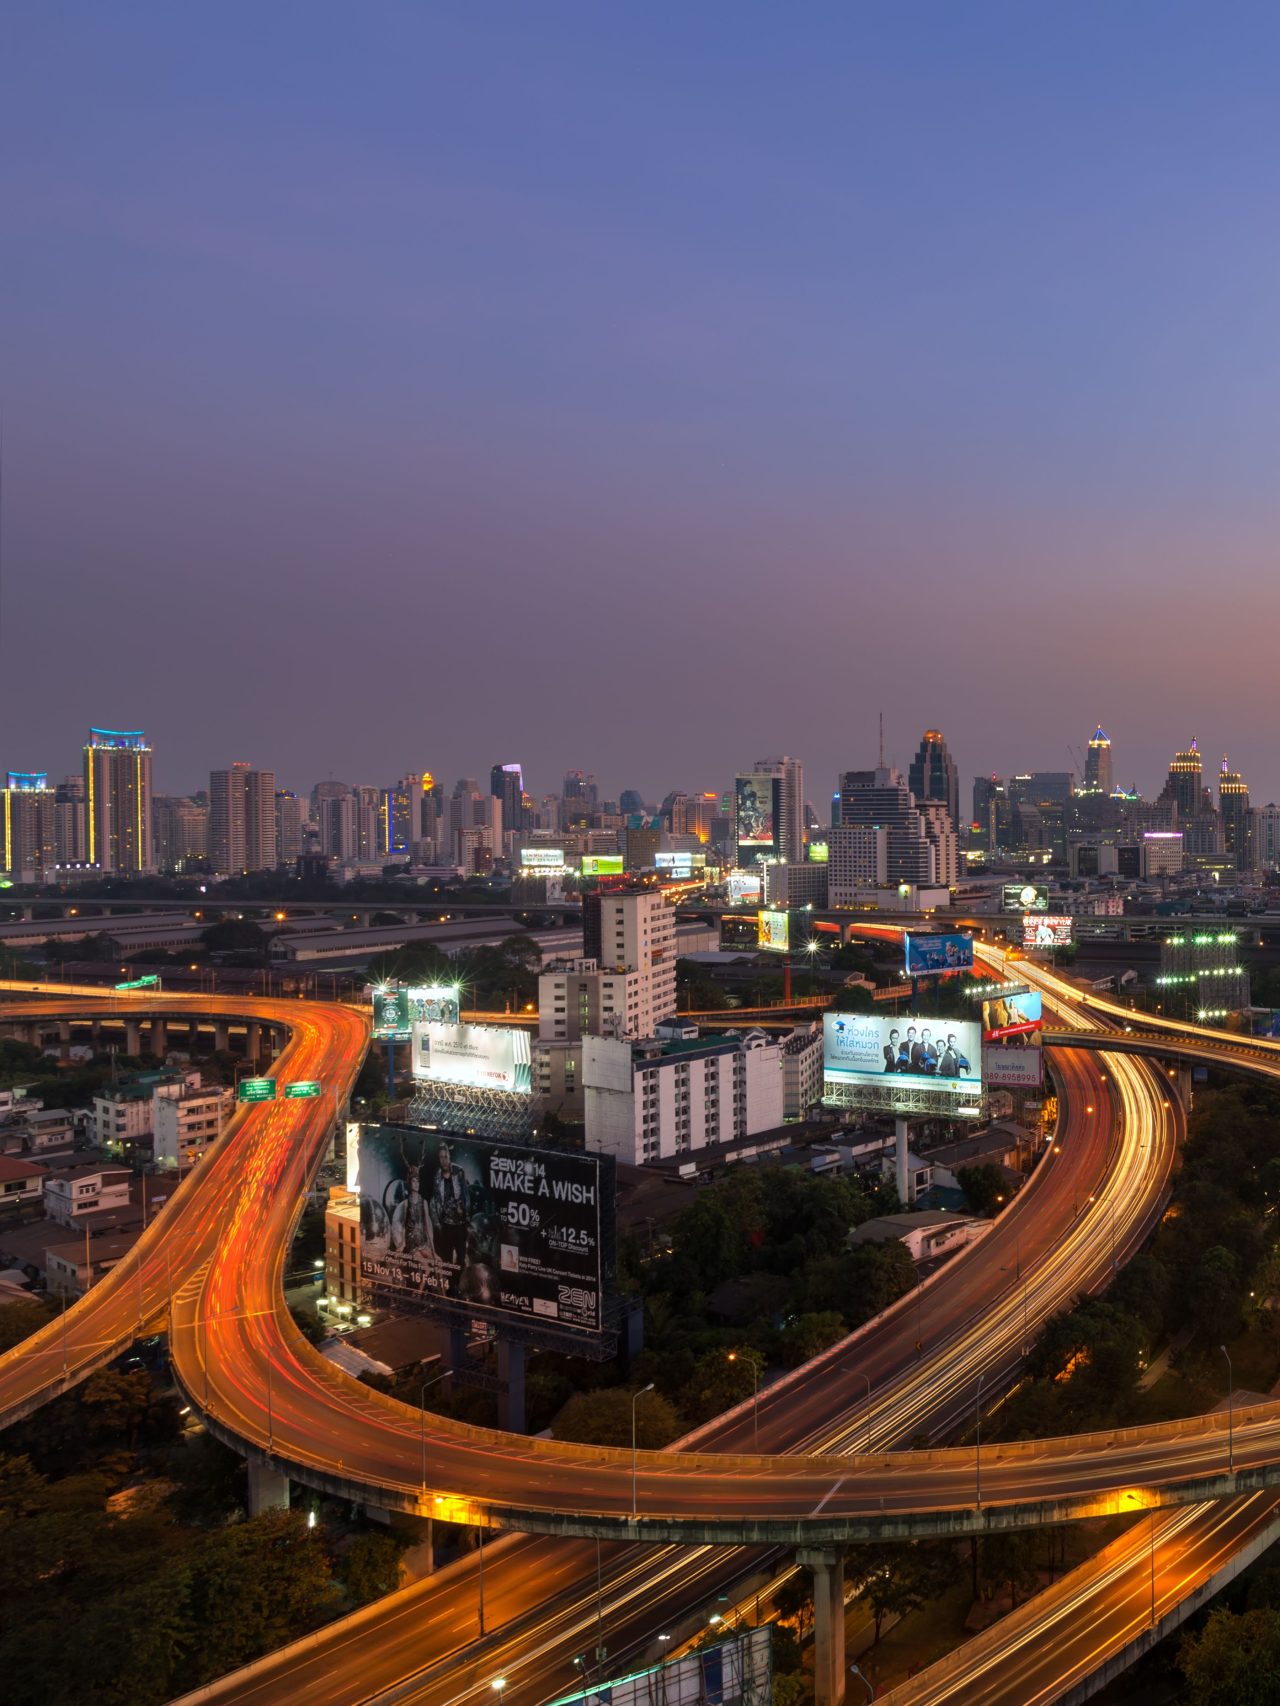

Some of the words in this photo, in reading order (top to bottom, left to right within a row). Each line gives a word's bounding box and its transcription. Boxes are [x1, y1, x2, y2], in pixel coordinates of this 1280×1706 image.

[836, 1035, 880, 1050] ให้ใส่หมวก
[489, 1156, 516, 1172] ZEN
[489, 1170, 535, 1195] MAKE
[538, 1178, 550, 1198] A
[552, 1180, 595, 1205] WISH
[508, 1201, 540, 1226] 50%
[560, 1226, 595, 1247] 12.5%
[362, 1261, 373, 1272] 15
[374, 1263, 390, 1276] Nov
[391, 1268, 402, 1279] 13
[410, 1271, 421, 1283] 16
[422, 1274, 438, 1287] Feb
[439, 1279, 449, 1290] 14
[558, 1284, 596, 1310] ZEN
